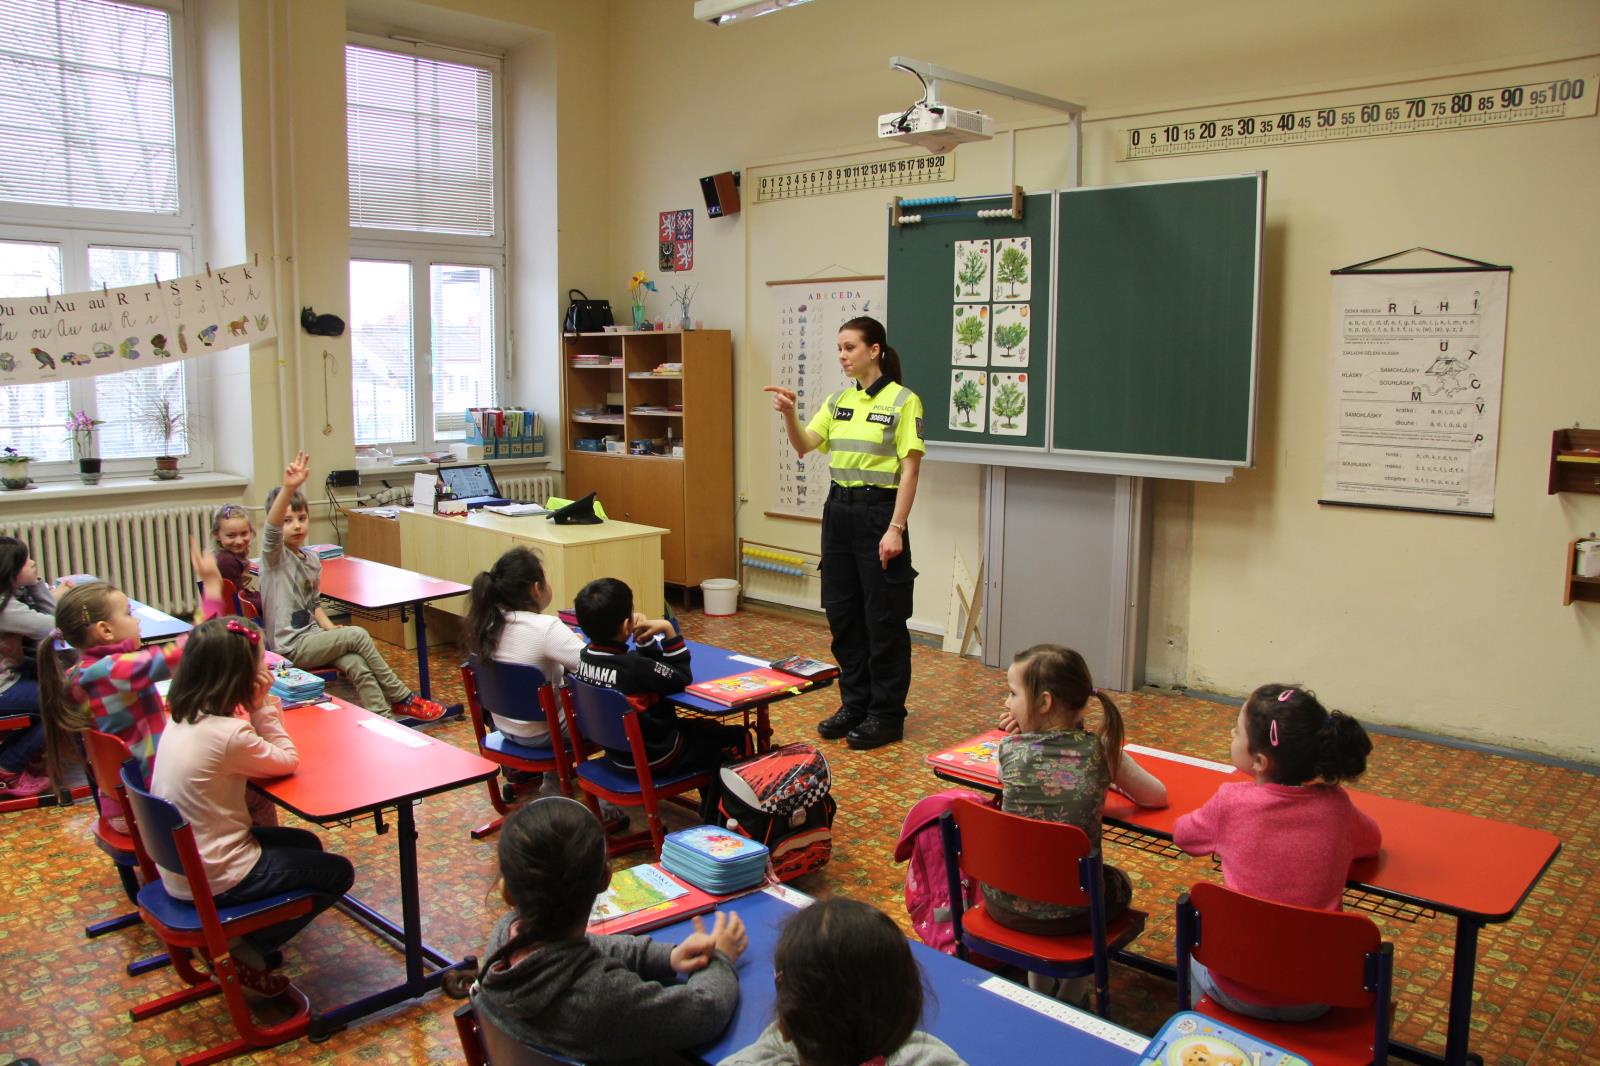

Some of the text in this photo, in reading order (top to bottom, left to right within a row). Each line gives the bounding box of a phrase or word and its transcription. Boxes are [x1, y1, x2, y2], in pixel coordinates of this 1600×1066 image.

[1132, 79, 1584, 146] 0 5 10 15 20 25 30 35 40 45 50 55 60 65 70 75 80 85 90 95 100
[762, 156, 944, 188] 0 1 2 3 4 5 6 7 8 9 10 11 12 13 14 15 16 17 18 19 20
[30, 306, 48, 314] ou
[55, 301, 75, 312] Au
[89, 300, 105, 309] au
[117, 293, 128, 305] R
[145, 293, 150, 301] r
[171, 280, 180, 296] Š
[195, 280, 202, 292] š
[218, 273, 229, 284] K
[244, 268, 252, 279] k
[1389, 304, 1396, 312] R
[1414, 306, 1420, 314] L
[1440, 302, 1448, 311] H
[1468, 350, 1477, 360] T
[1471, 380, 1480, 389] C
[1412, 392, 1421, 400] M
[1476, 404, 1484, 413] V
[1475, 434, 1483, 442] P
[580, 661, 617, 684] YAMAHA
